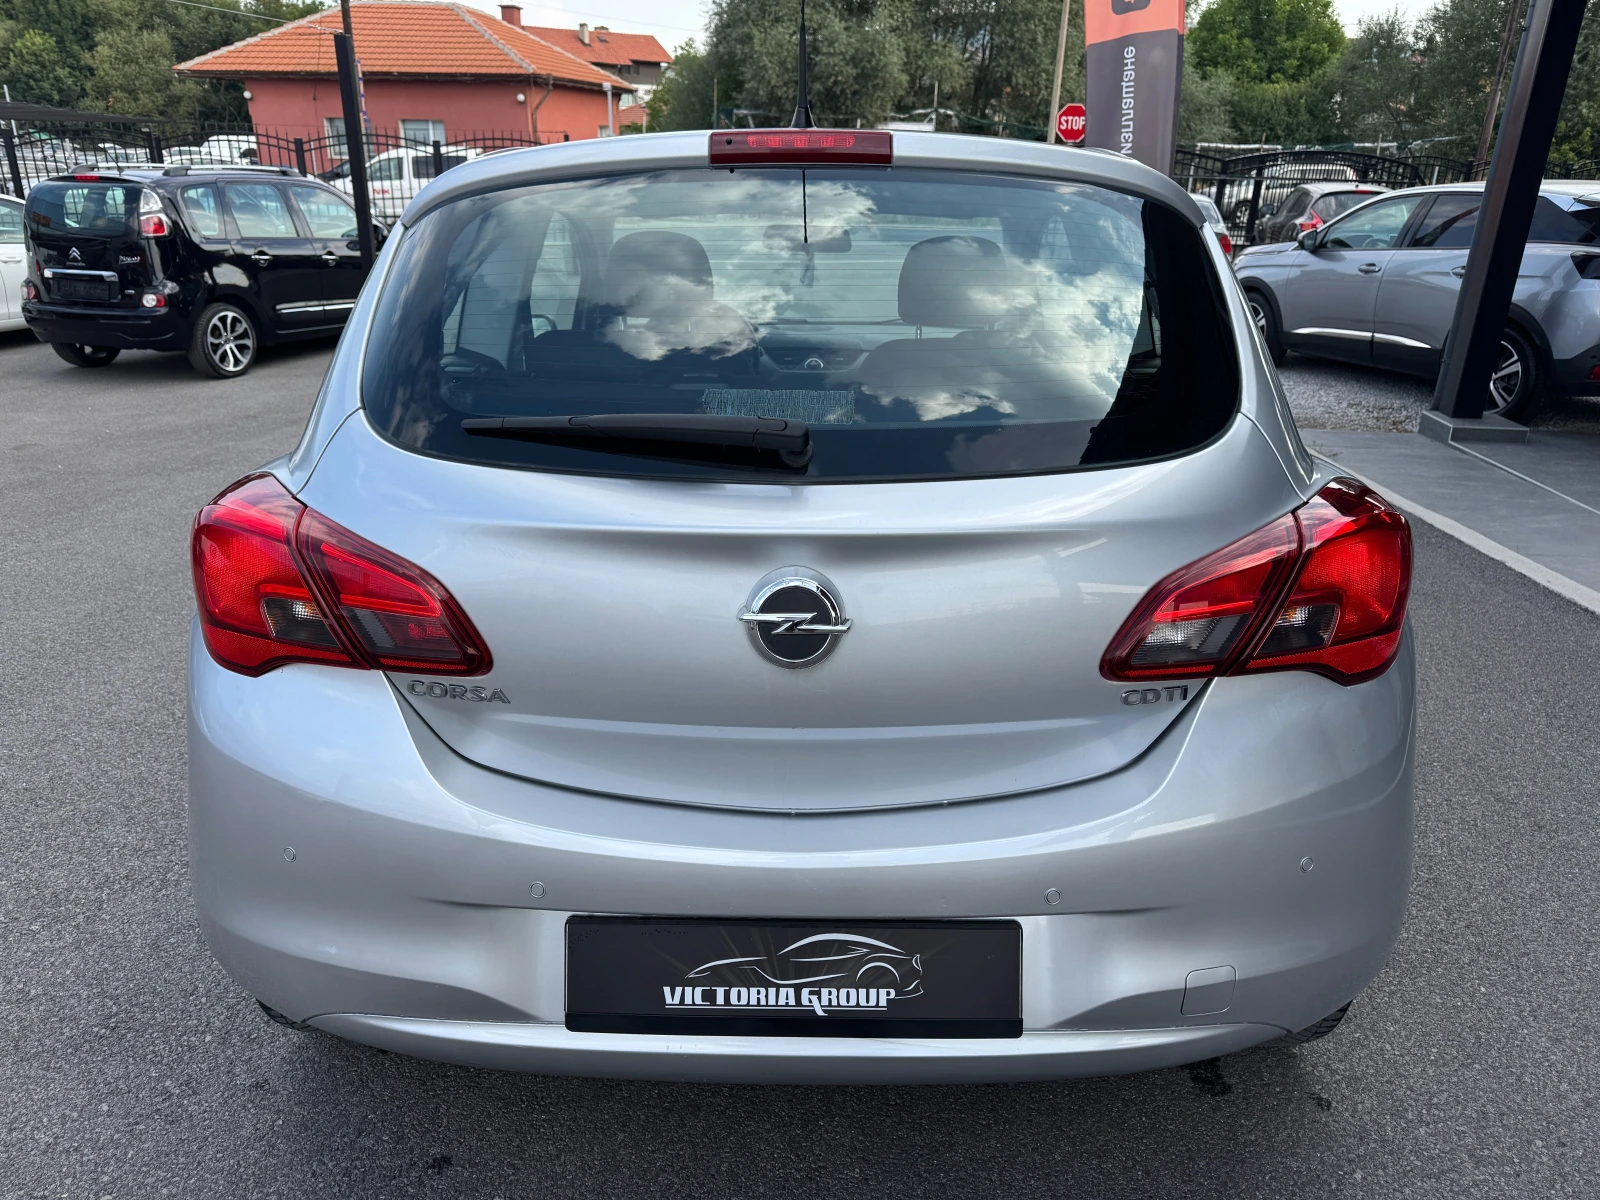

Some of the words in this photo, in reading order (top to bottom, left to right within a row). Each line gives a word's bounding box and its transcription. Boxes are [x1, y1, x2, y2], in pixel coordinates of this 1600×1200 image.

[407, 679, 511, 704] CORSA
[1120, 685, 1188, 706] CDTI
[663, 986, 796, 1006] VICTORIA
[800, 987, 896, 1016] GROUP
